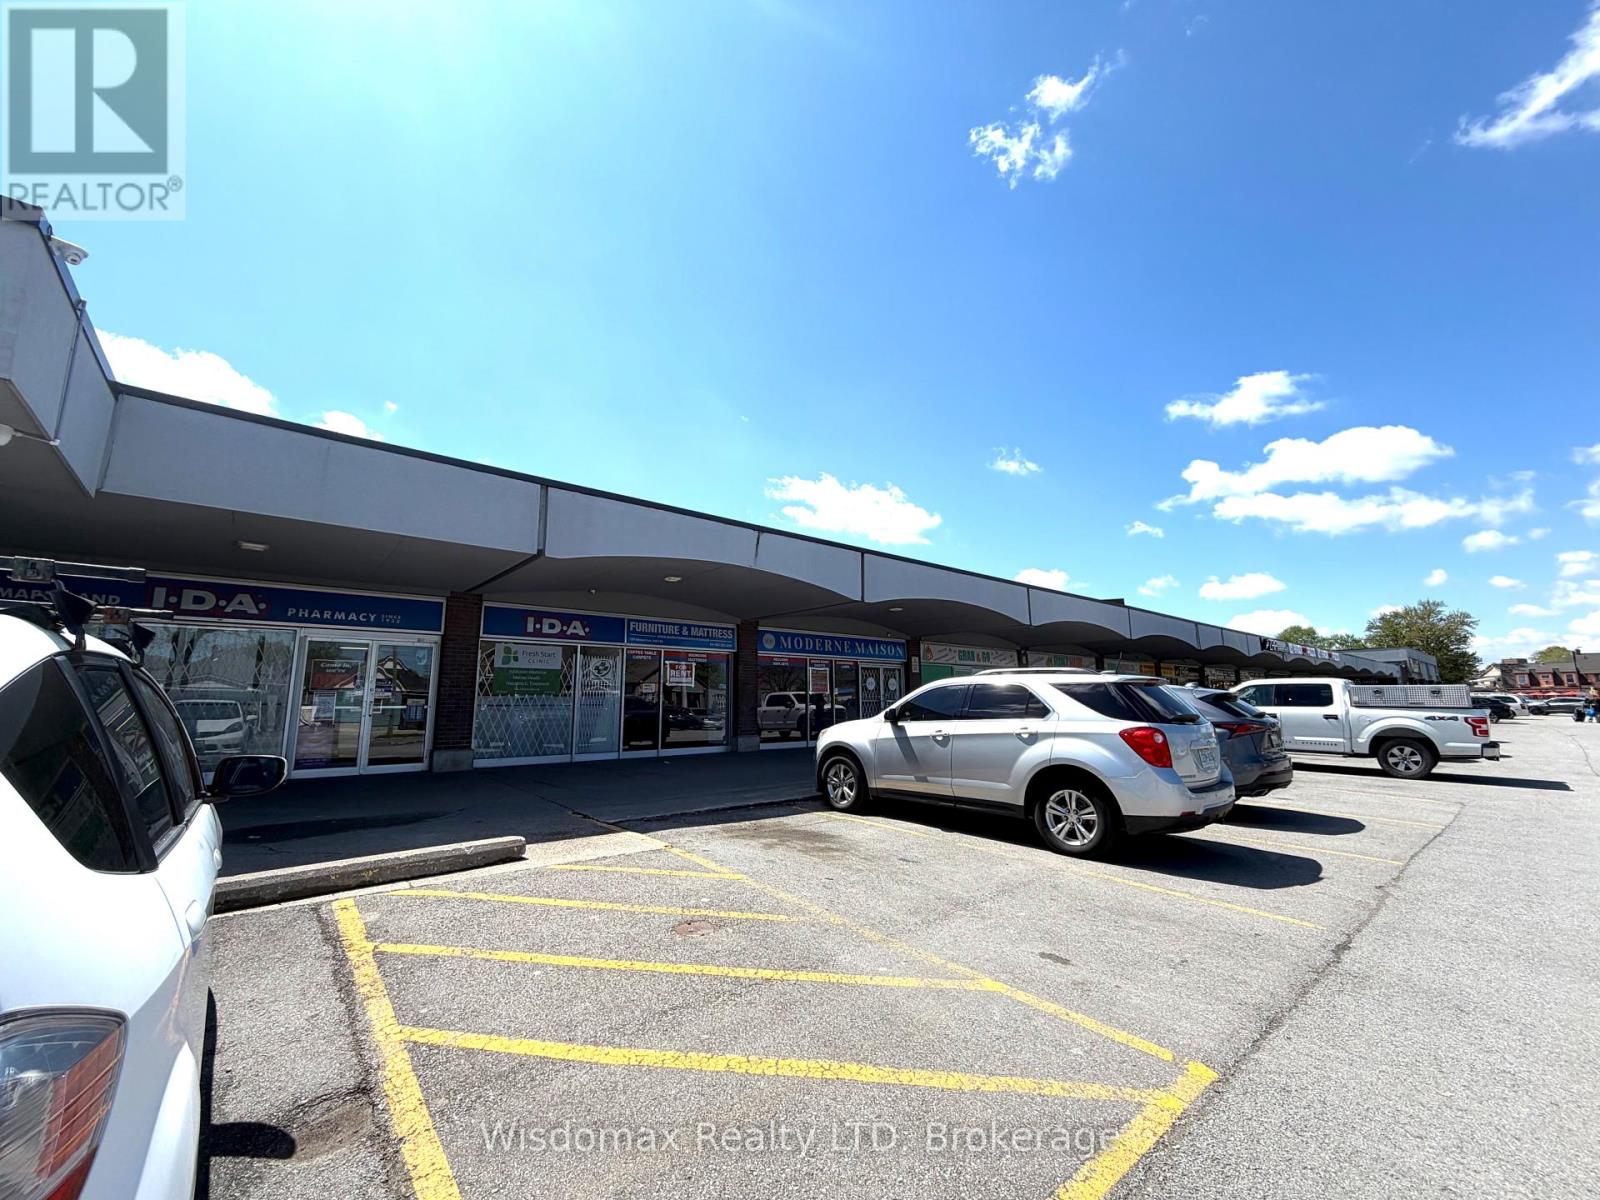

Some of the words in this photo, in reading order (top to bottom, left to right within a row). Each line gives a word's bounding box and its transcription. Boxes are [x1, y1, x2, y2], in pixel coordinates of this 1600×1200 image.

[287, 607, 377, 622] PHARMACY
[630, 621, 680, 635] FURNITURE
[682, 625, 689, 635] &
[690, 626, 733, 639] MATTRESS
[780, 635, 851, 653] MODERNE
[855, 642, 904, 657] MAISON
[670, 669, 692, 678] RENT
